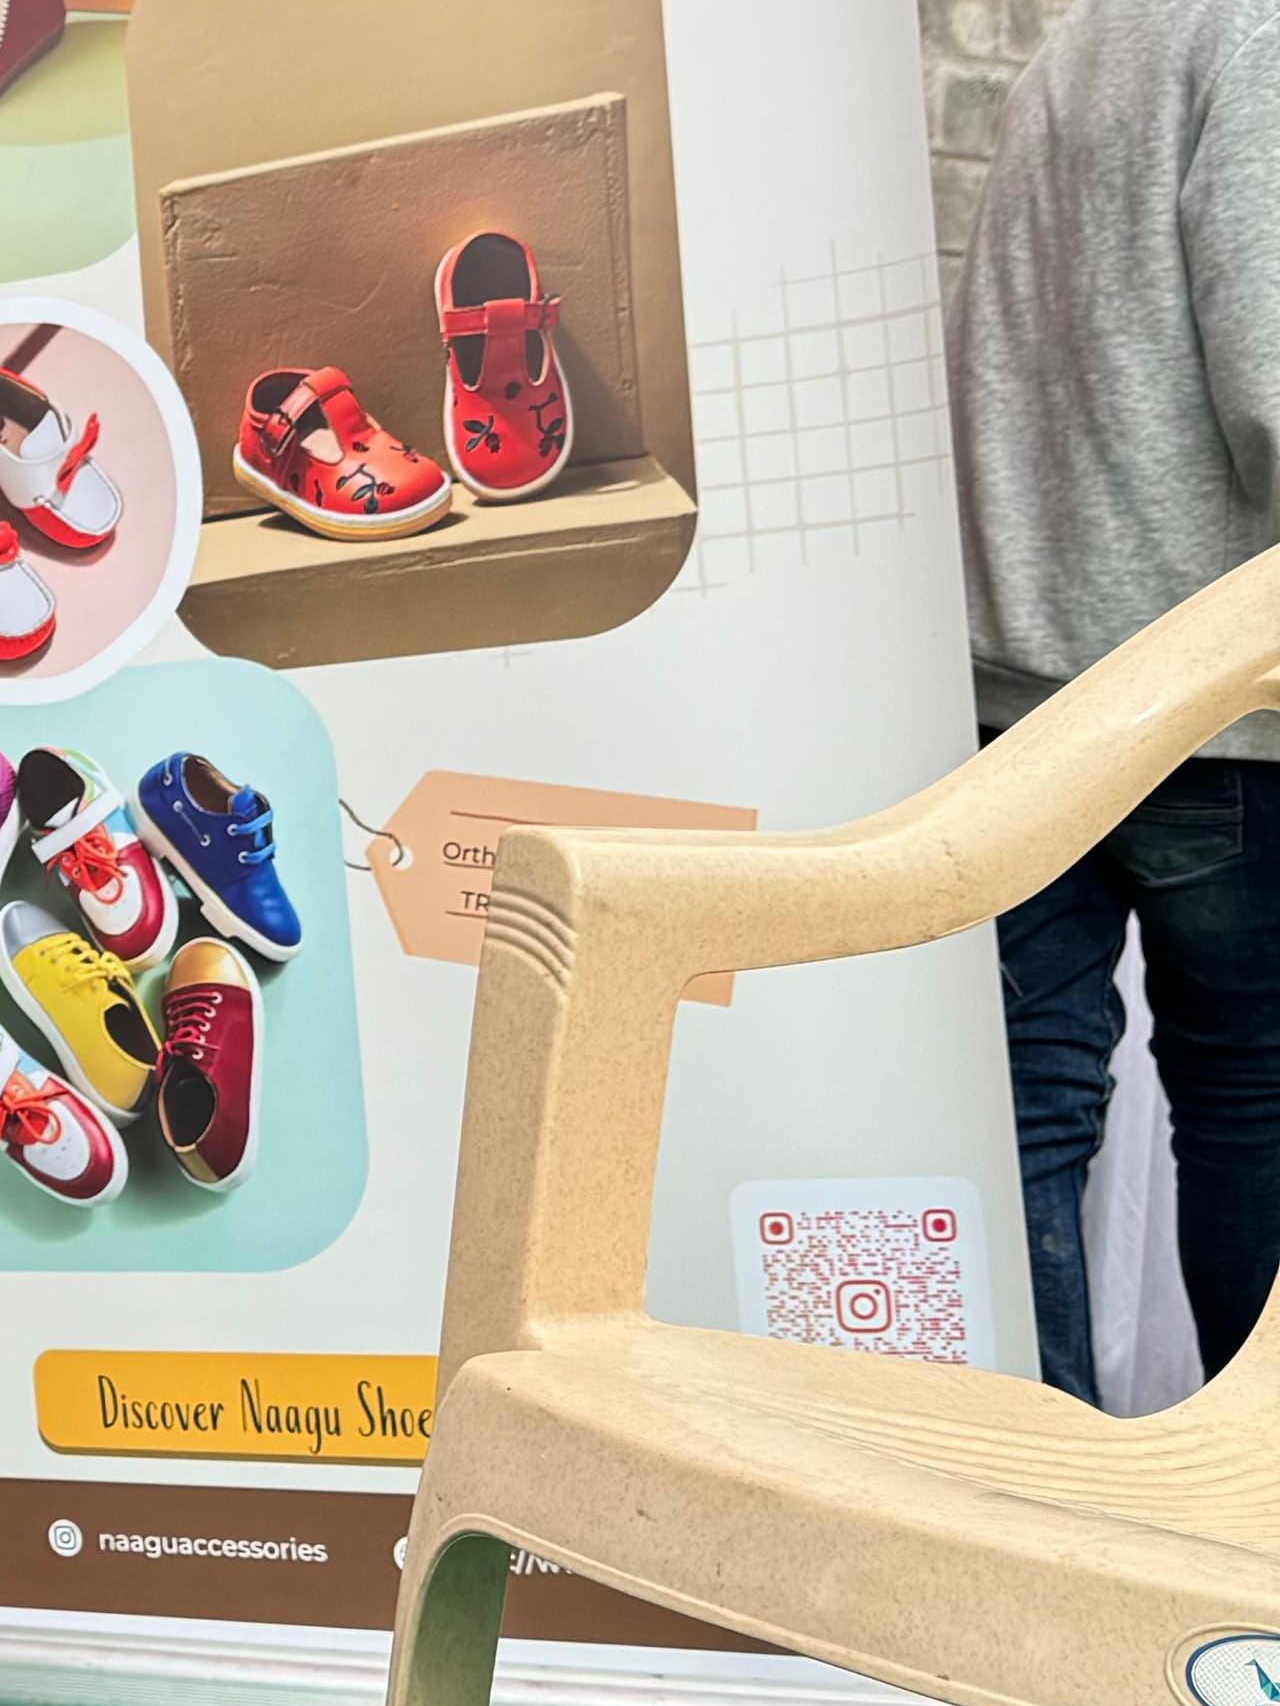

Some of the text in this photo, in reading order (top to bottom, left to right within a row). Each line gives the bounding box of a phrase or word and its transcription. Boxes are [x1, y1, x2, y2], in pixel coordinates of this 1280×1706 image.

[97, 1374, 225, 1431] Discover
[240, 1378, 342, 1454] Naagu
[99, 1530, 329, 1564] naaguaccessories
